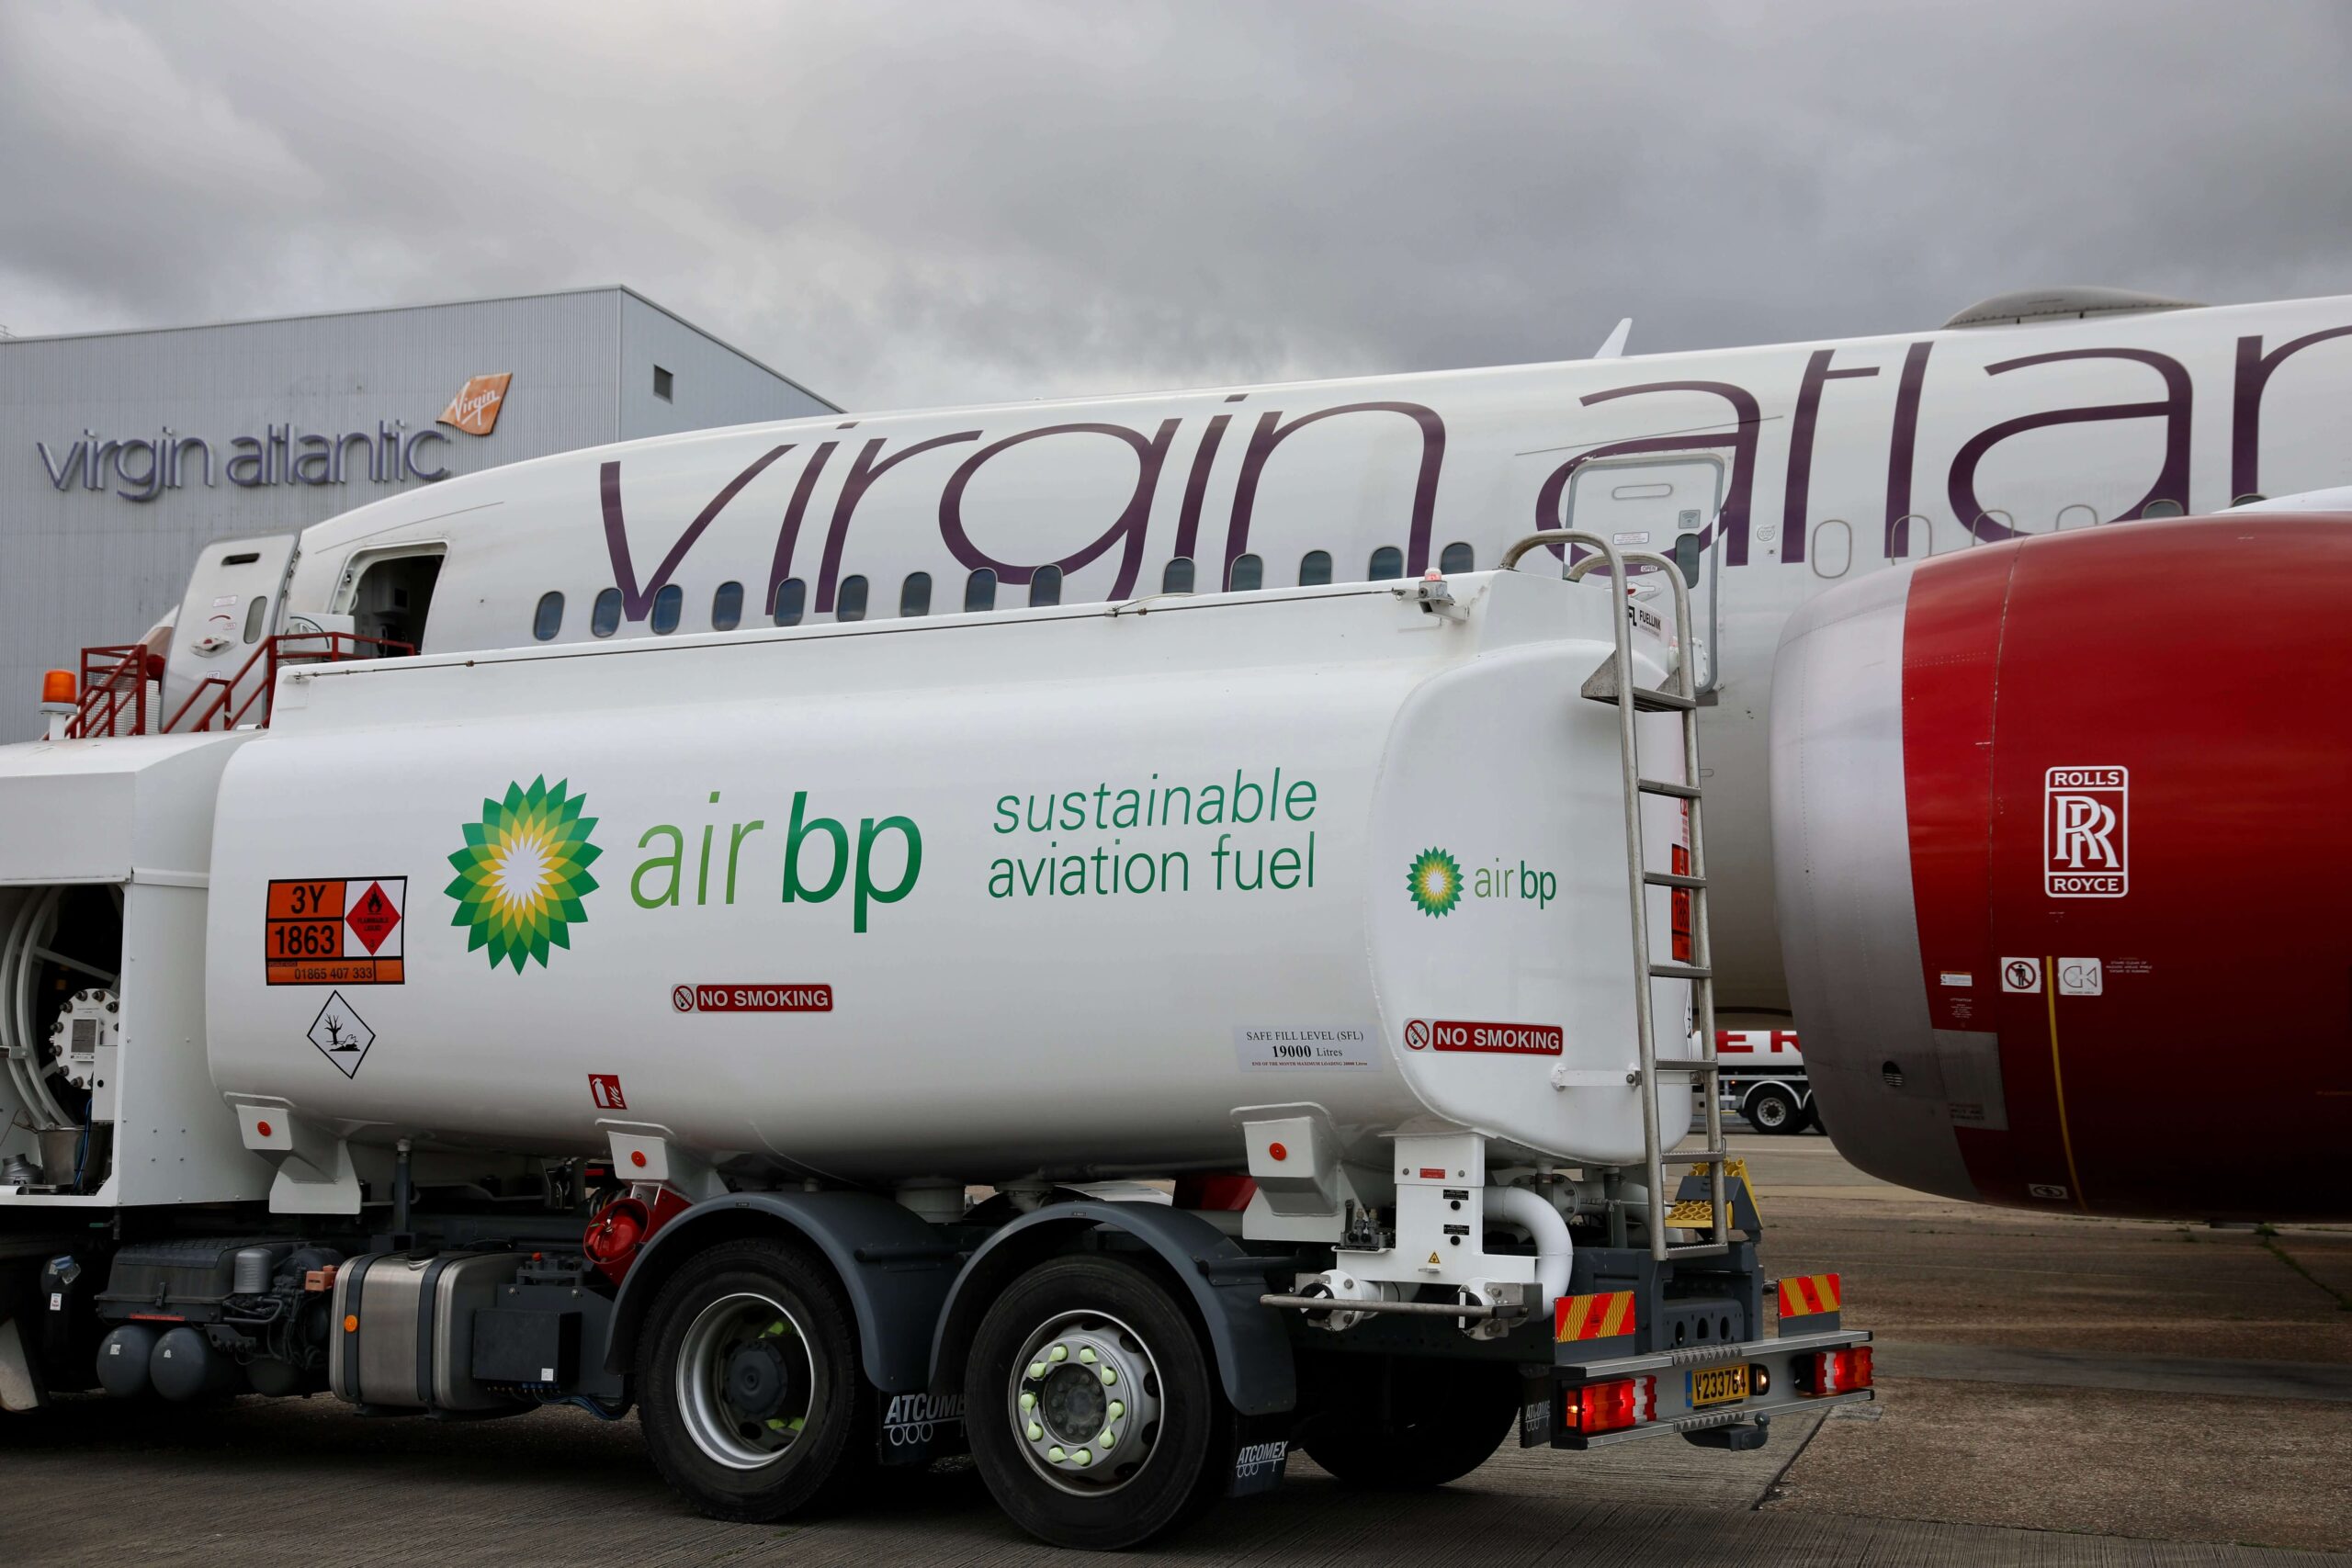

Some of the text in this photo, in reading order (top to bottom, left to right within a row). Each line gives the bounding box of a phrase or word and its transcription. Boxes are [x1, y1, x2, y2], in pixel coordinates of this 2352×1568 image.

[454, 381, 500, 426] Virgin
[37, 418, 452, 502] virgin atlantic
[600, 393, 1446, 622] virgin
[1639, 610, 1661, 631] FUELLINK
[2053, 772, 2120, 786] ROLLS
[993, 767, 1317, 834] sustainable
[630, 791, 922, 933] air bp
[988, 830, 1315, 898] aviation fuel
[1475, 857, 1556, 910] air bp
[2053, 878, 2120, 892] ROYCE
[290, 885, 326, 914] 3Y
[275, 925, 335, 954] 1863
[294, 967, 373, 979] 01865 407 333
[700, 990, 829, 1007] NO SMOKING
[1246, 1031, 1364, 1042] SAFE FILL LEVEL (SFL)
[1437, 1028, 1559, 1050] NO SMOKING
[1272, 1045, 1343, 1057] 19000 Litres
[1237, 1440, 1289, 1465] ATCOMEX
